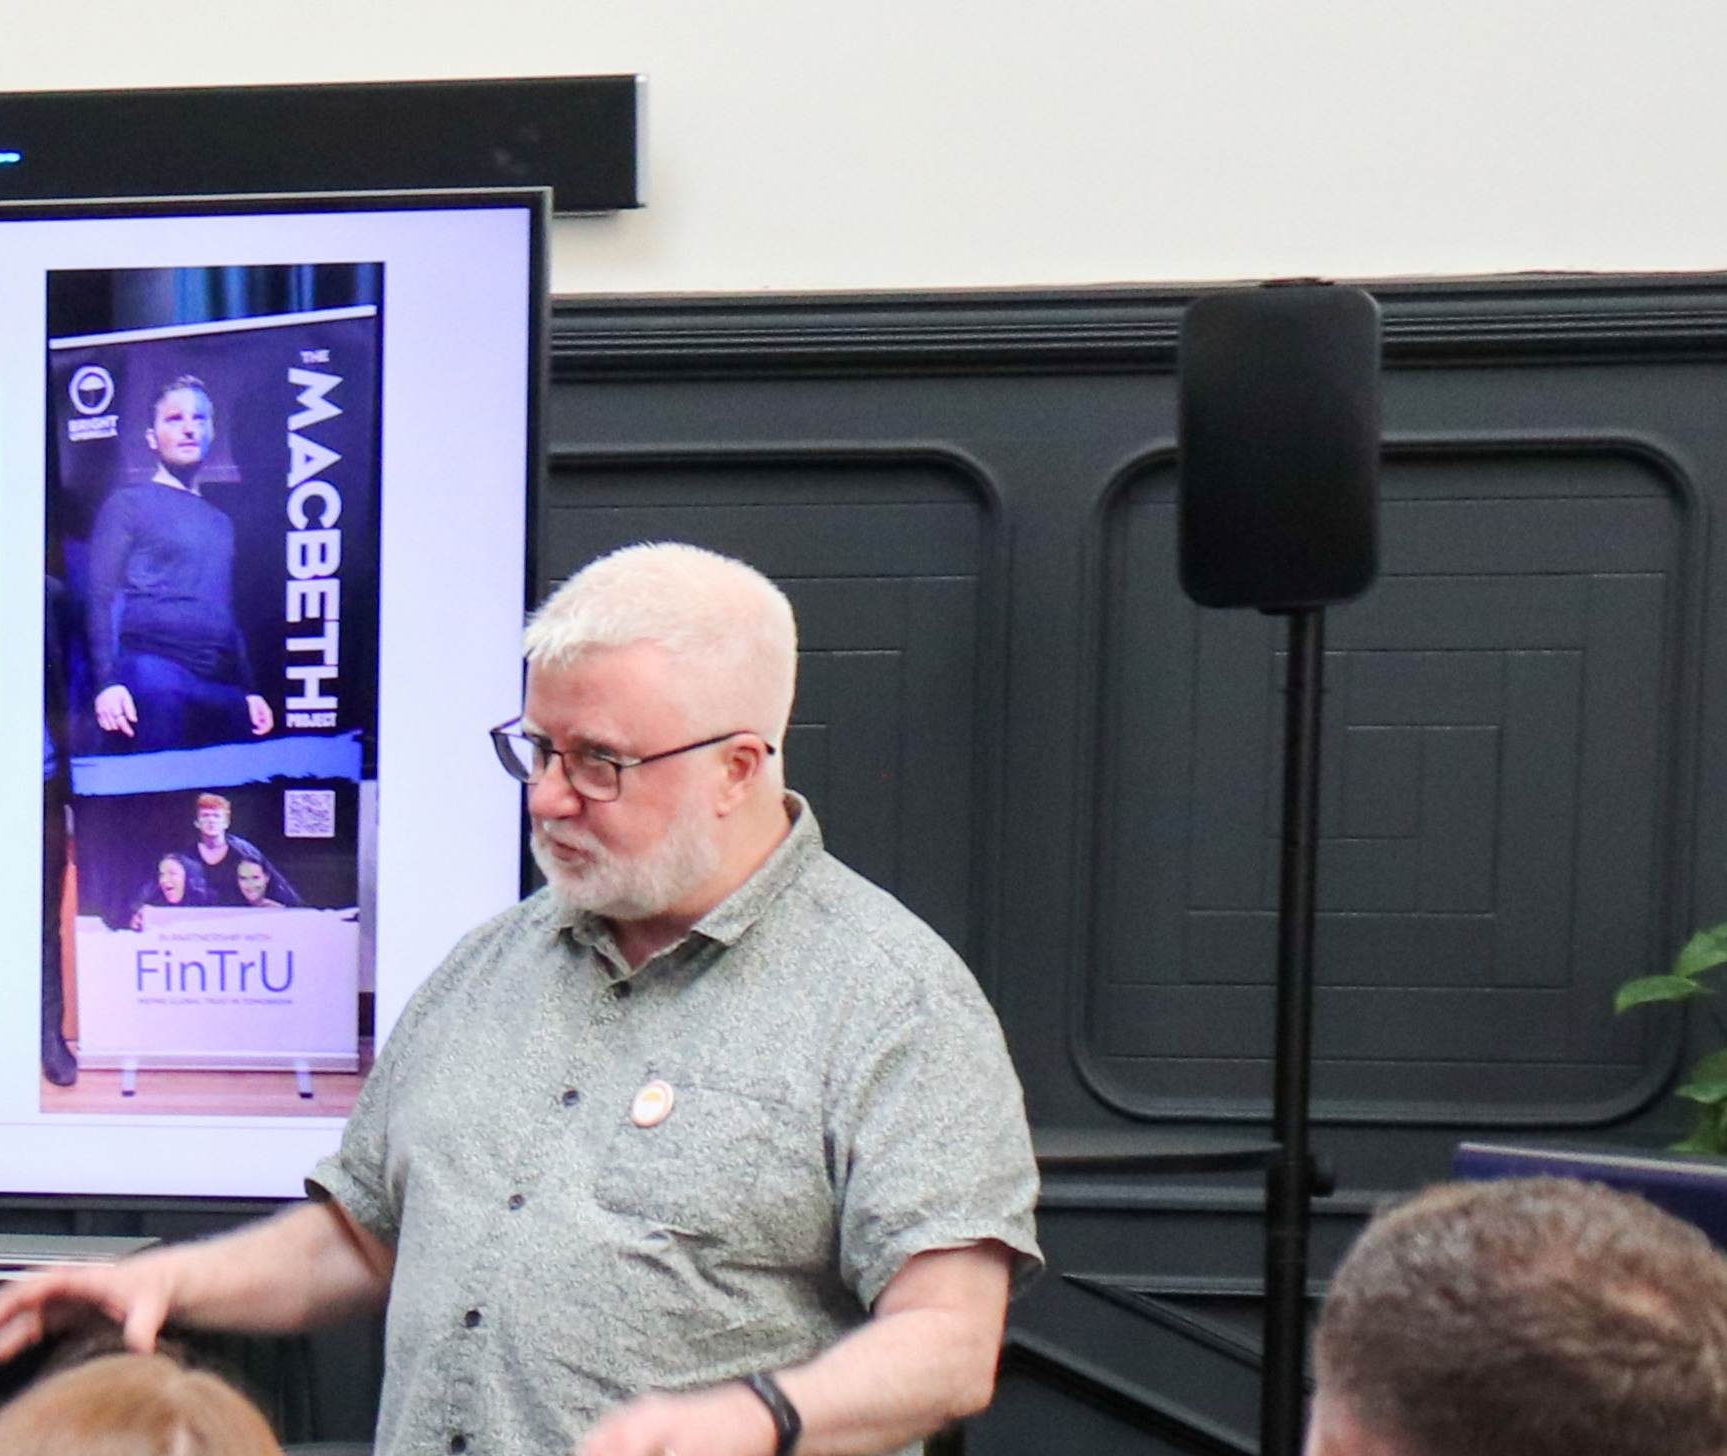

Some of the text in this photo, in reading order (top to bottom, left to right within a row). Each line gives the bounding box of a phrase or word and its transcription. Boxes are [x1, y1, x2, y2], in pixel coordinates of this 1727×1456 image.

[300, 349, 330, 364] THE
[285, 367, 343, 711] MACBETH
[136, 949, 294, 993] FinTrU
